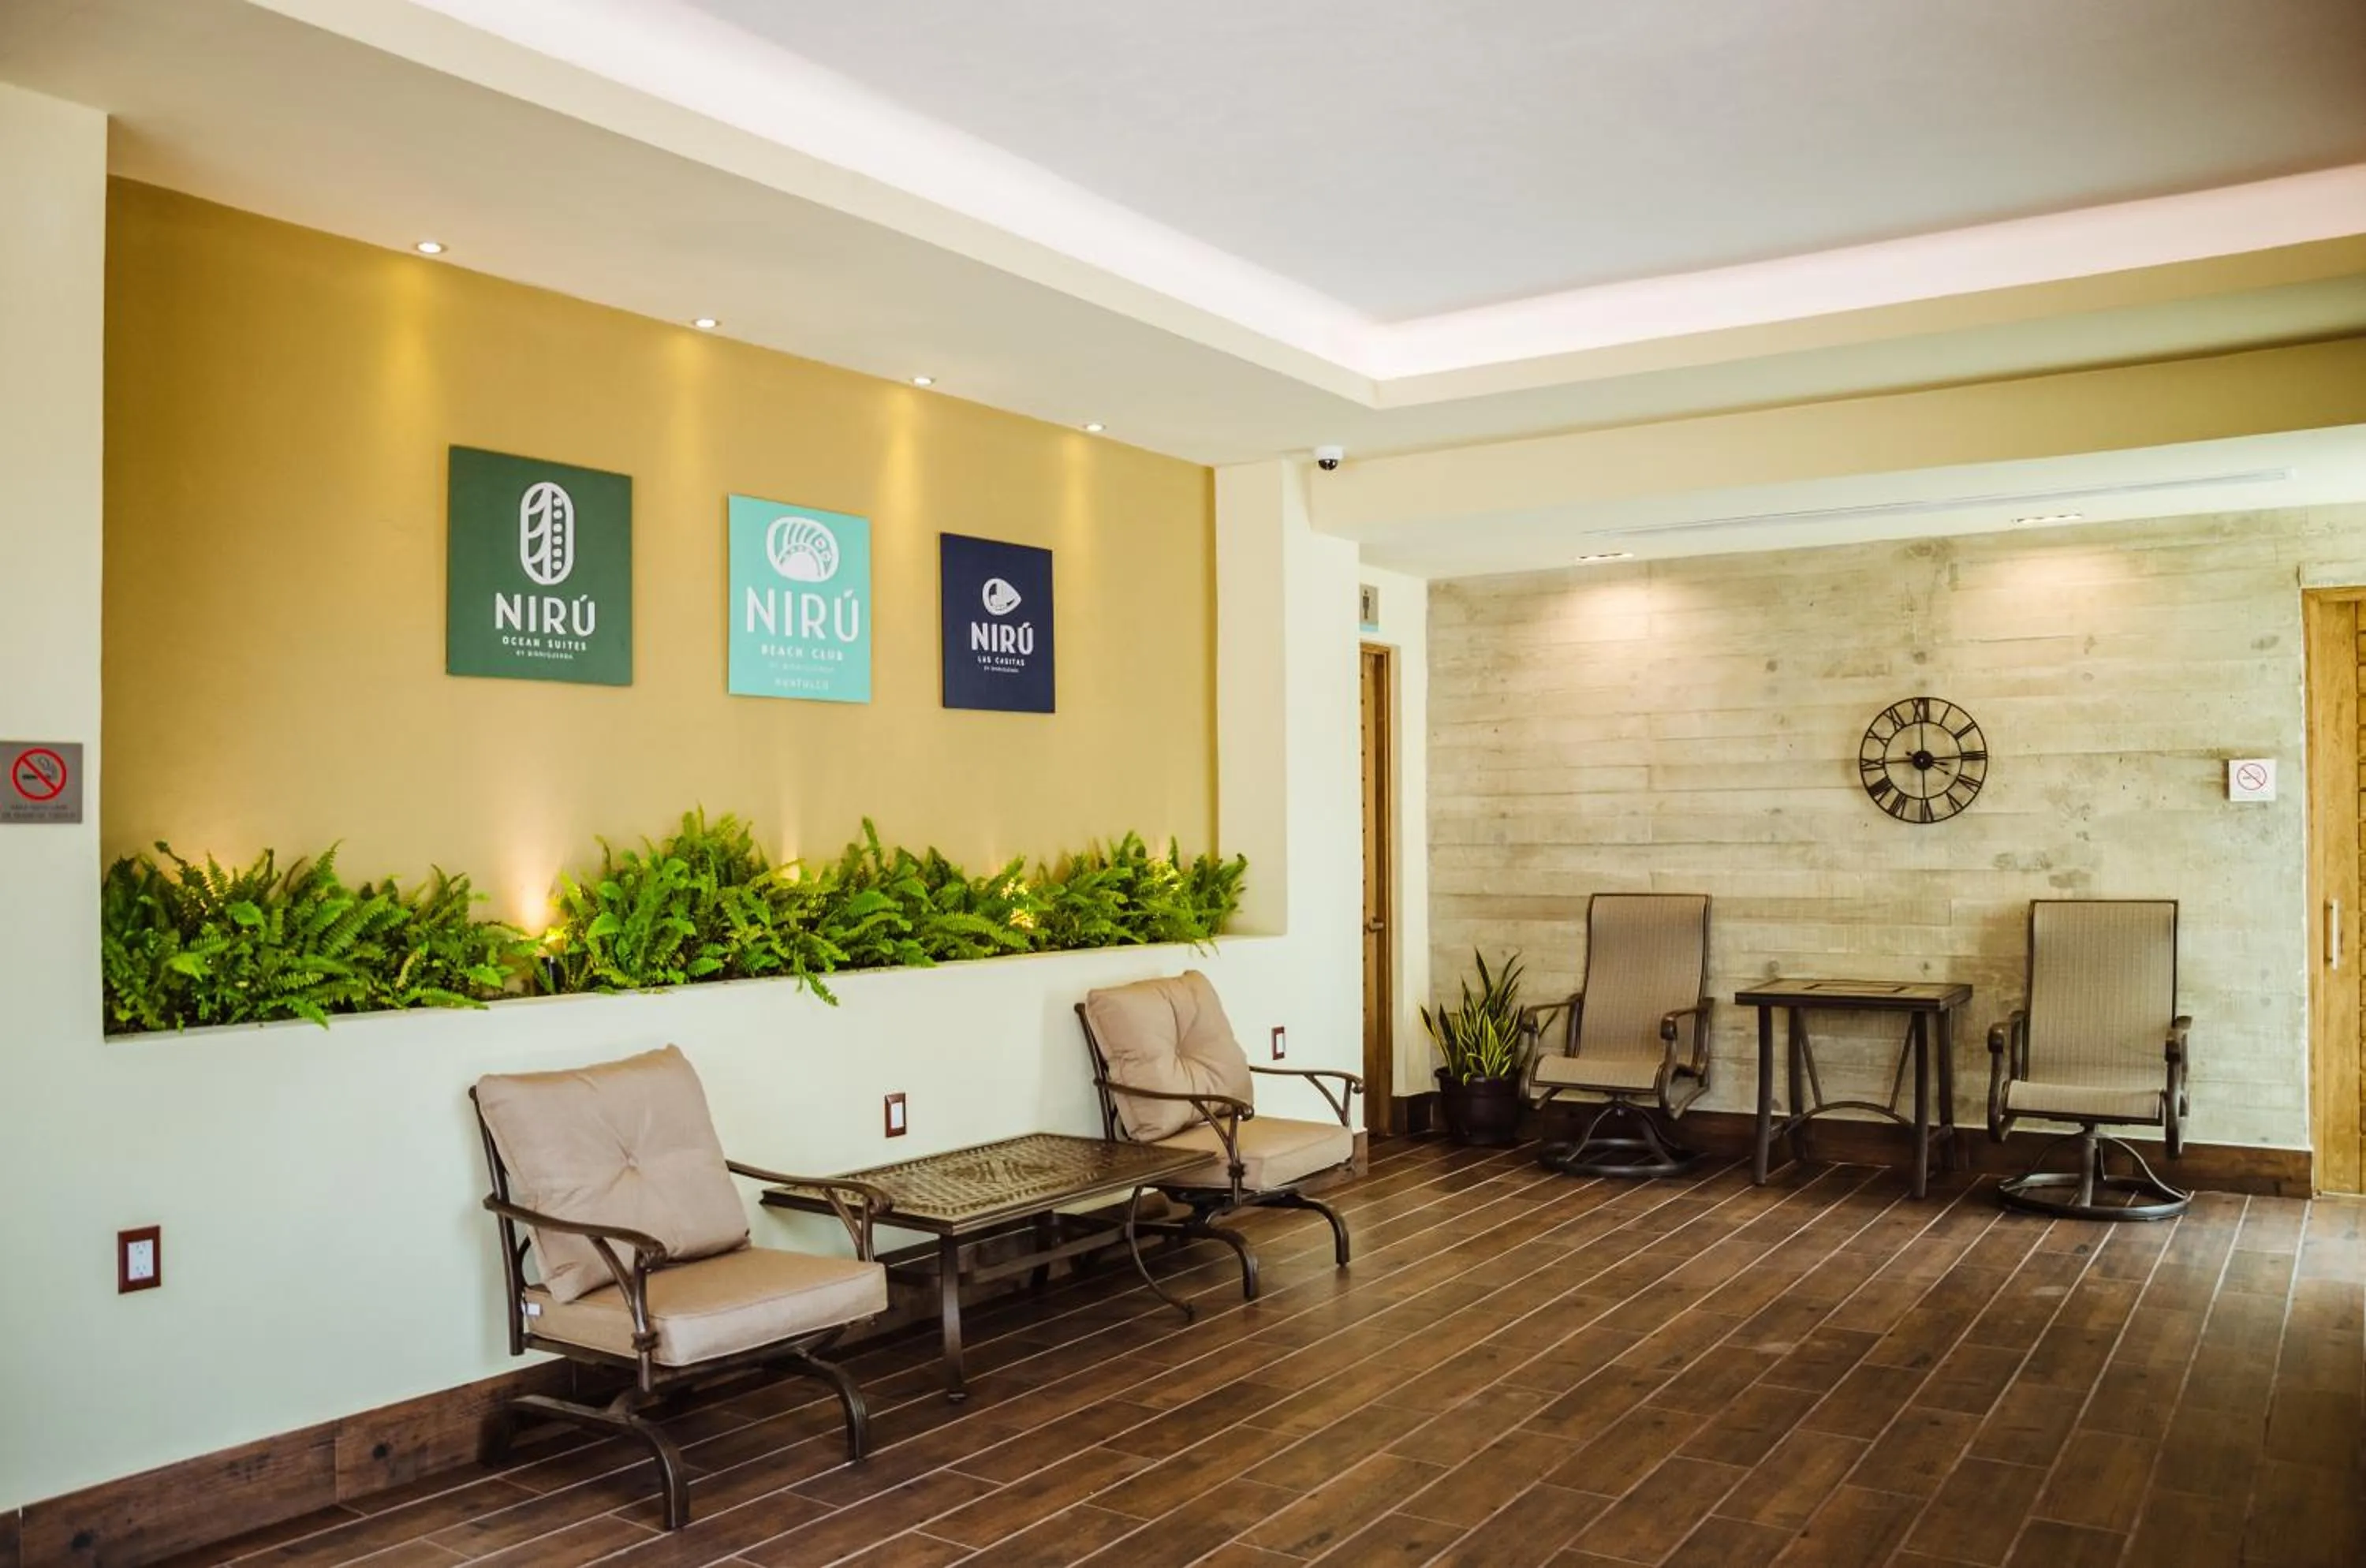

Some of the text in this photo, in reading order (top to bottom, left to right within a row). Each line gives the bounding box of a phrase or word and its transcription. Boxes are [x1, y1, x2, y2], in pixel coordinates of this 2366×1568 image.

[494, 592, 596, 637] NIRÚ
[747, 586, 860, 643] NIRÚ
[502, 635, 587, 651] OCEAN SUITES
[971, 621, 1034, 655] NIRÚ
[761, 644, 844, 661] BEACH CLUB
[977, 655, 1025, 666] LAS CASITAS
